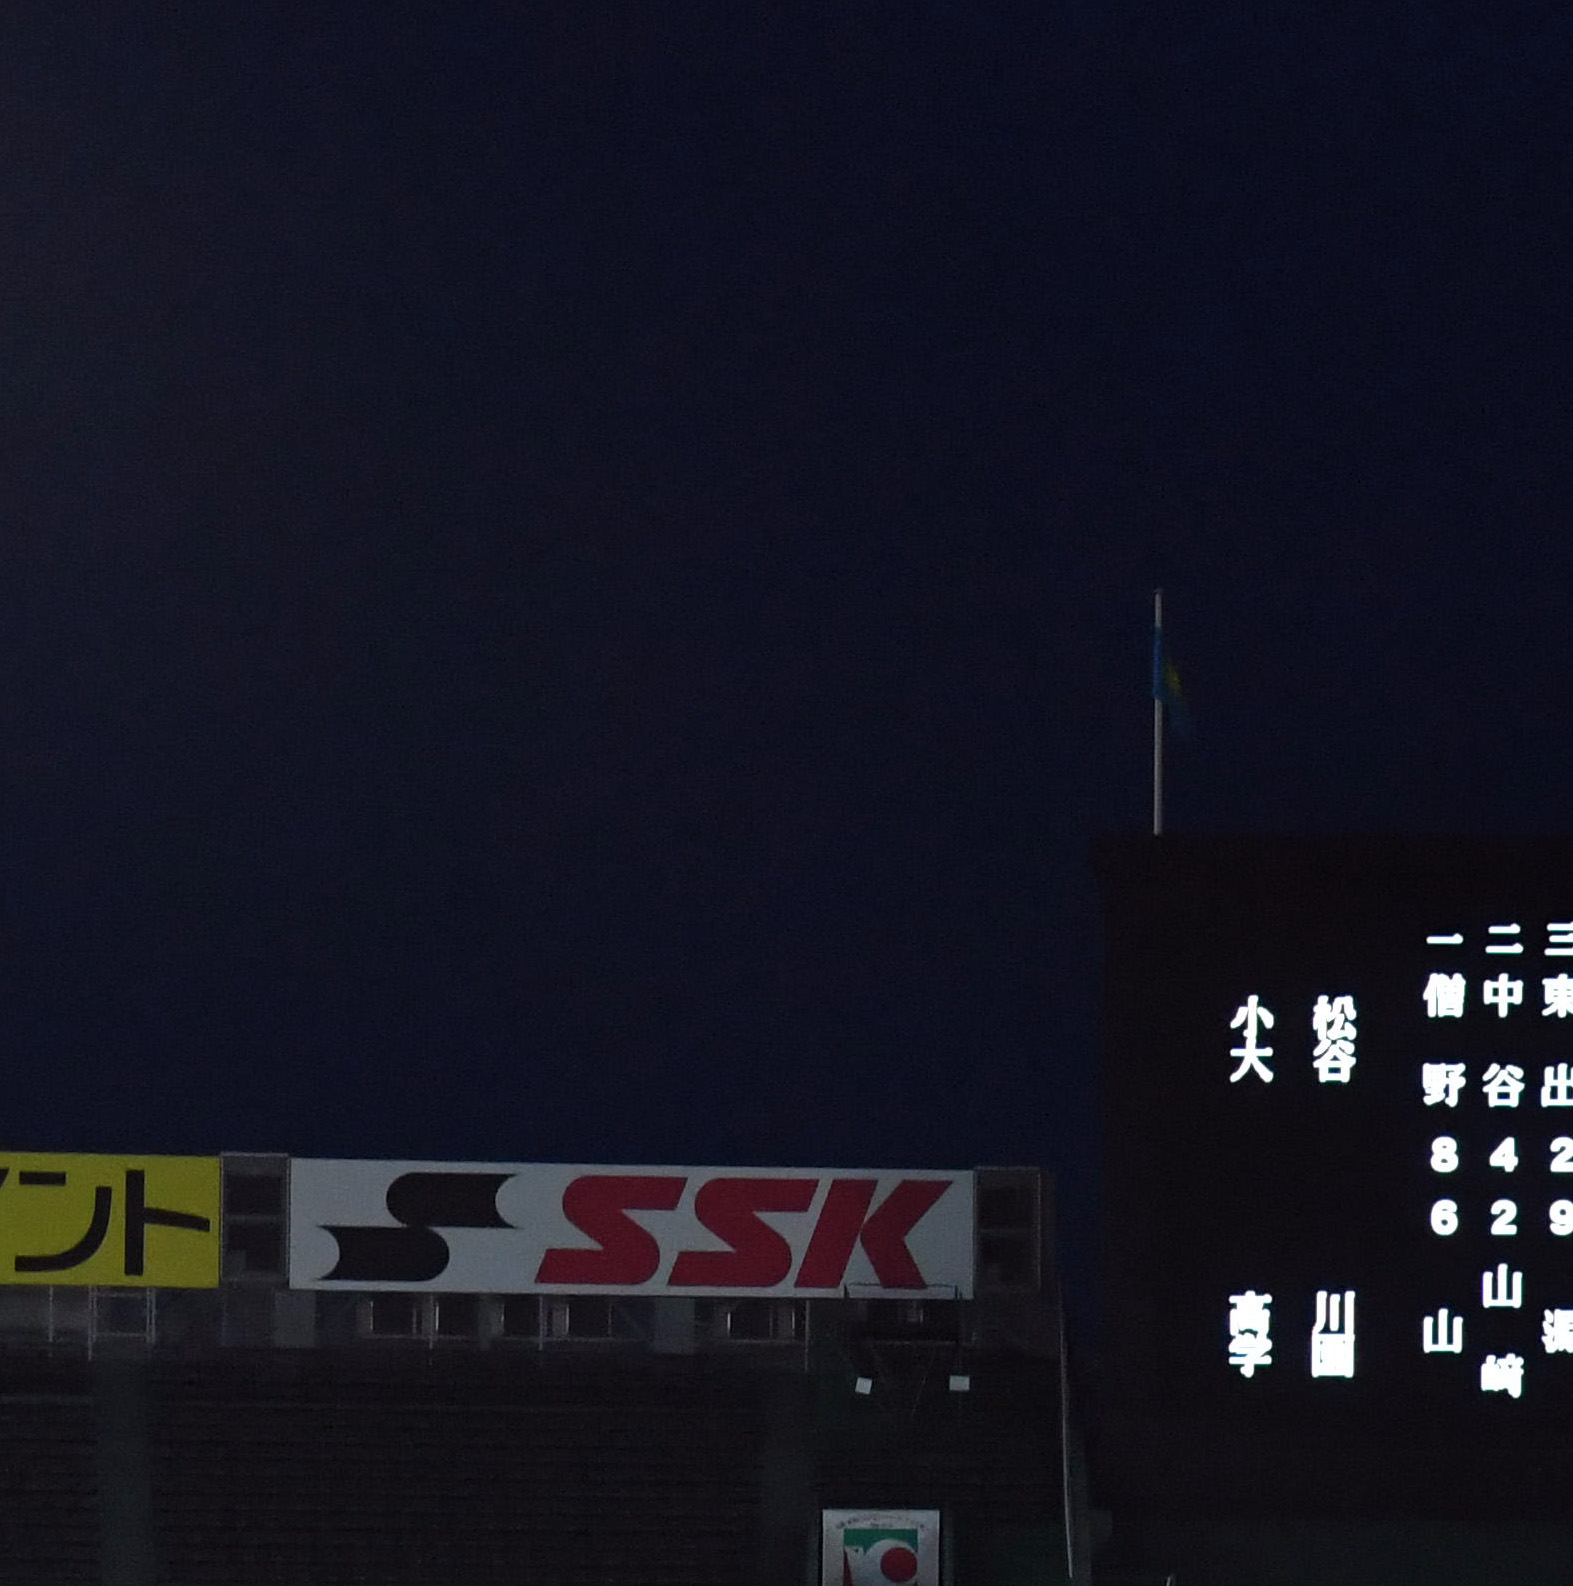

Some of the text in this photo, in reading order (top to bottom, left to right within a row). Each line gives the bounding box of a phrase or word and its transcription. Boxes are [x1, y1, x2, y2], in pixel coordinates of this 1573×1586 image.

[1486, 923, 1523, 953] 二
[1430, 1136, 1458, 1172] 8
[1490, 1137, 1518, 1172] 4
[534, 1175, 955, 1290] SSK
[1430, 1199, 1458, 1235] 6
[1491, 1199, 1517, 1235] 2
[1423, 1308, 1463, 1353] 山
